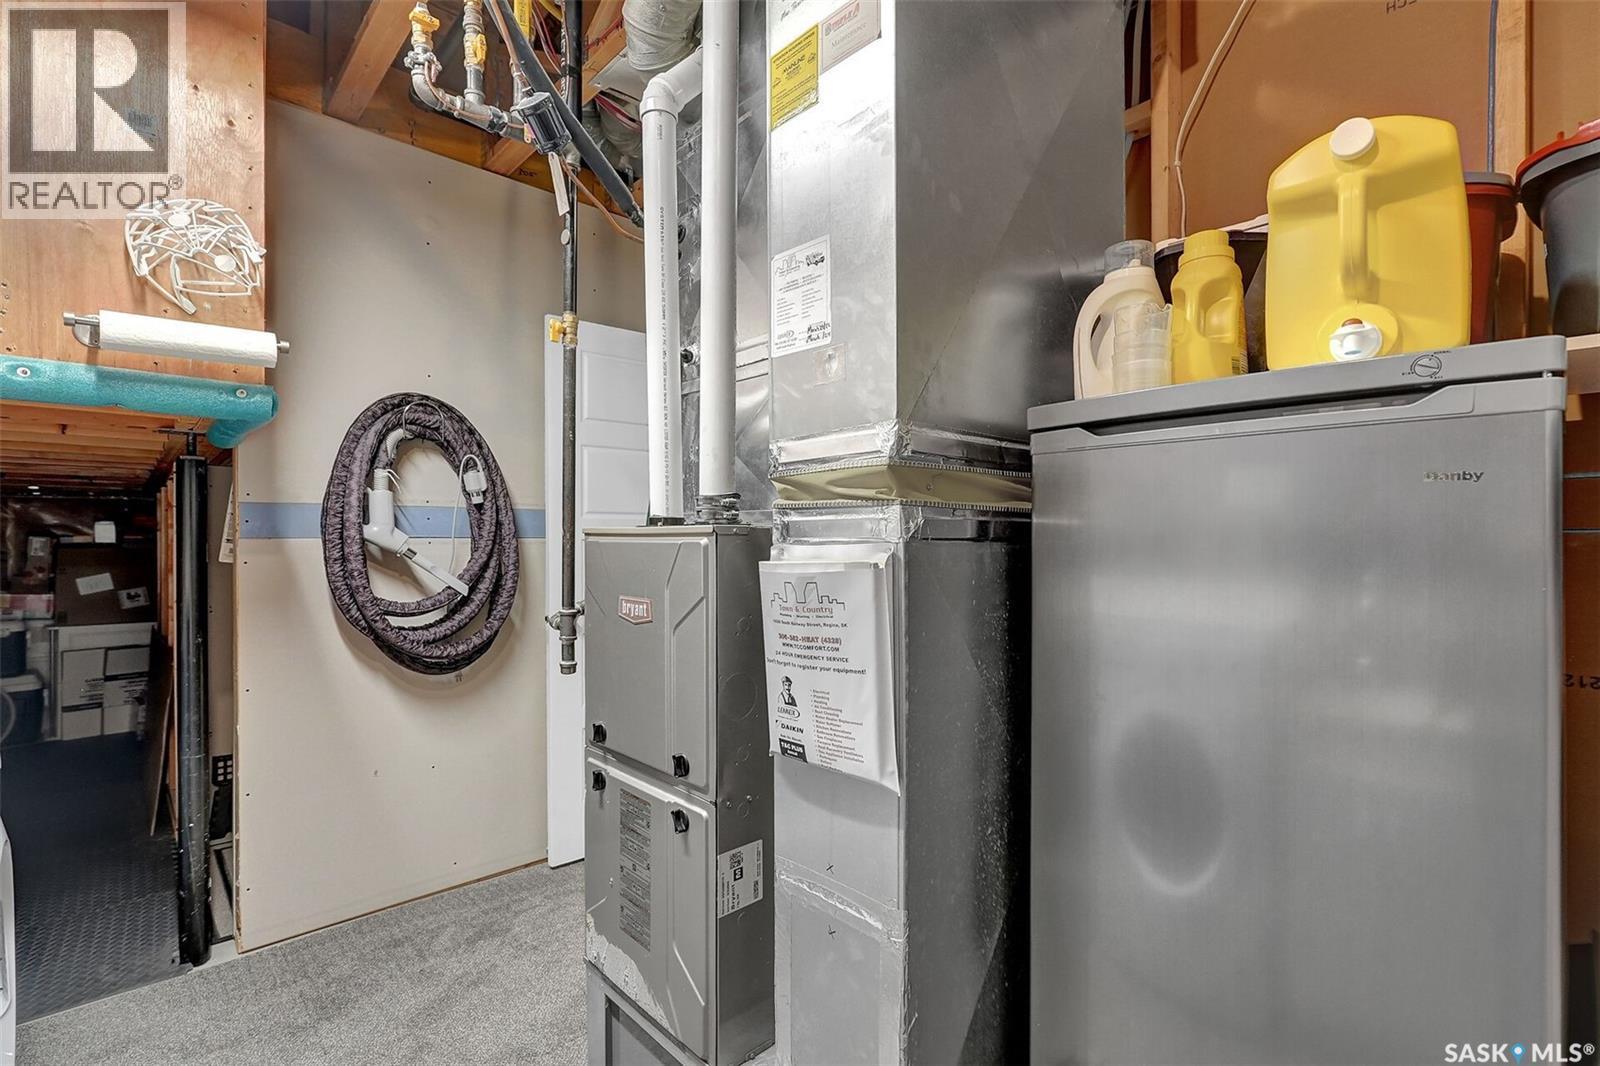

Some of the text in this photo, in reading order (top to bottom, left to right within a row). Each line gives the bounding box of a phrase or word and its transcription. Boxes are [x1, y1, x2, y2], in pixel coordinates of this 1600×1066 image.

[622, 600, 647, 617] bryant
[802, 606, 833, 614] Country
[782, 642, 840, 652] WWW.TCCOMFORT.COM
[794, 653, 825, 661] EMERGENCY
[797, 662, 818, 671] register
[833, 665, 867, 675] equipment!
[781, 723, 804, 734] DAIKIN
